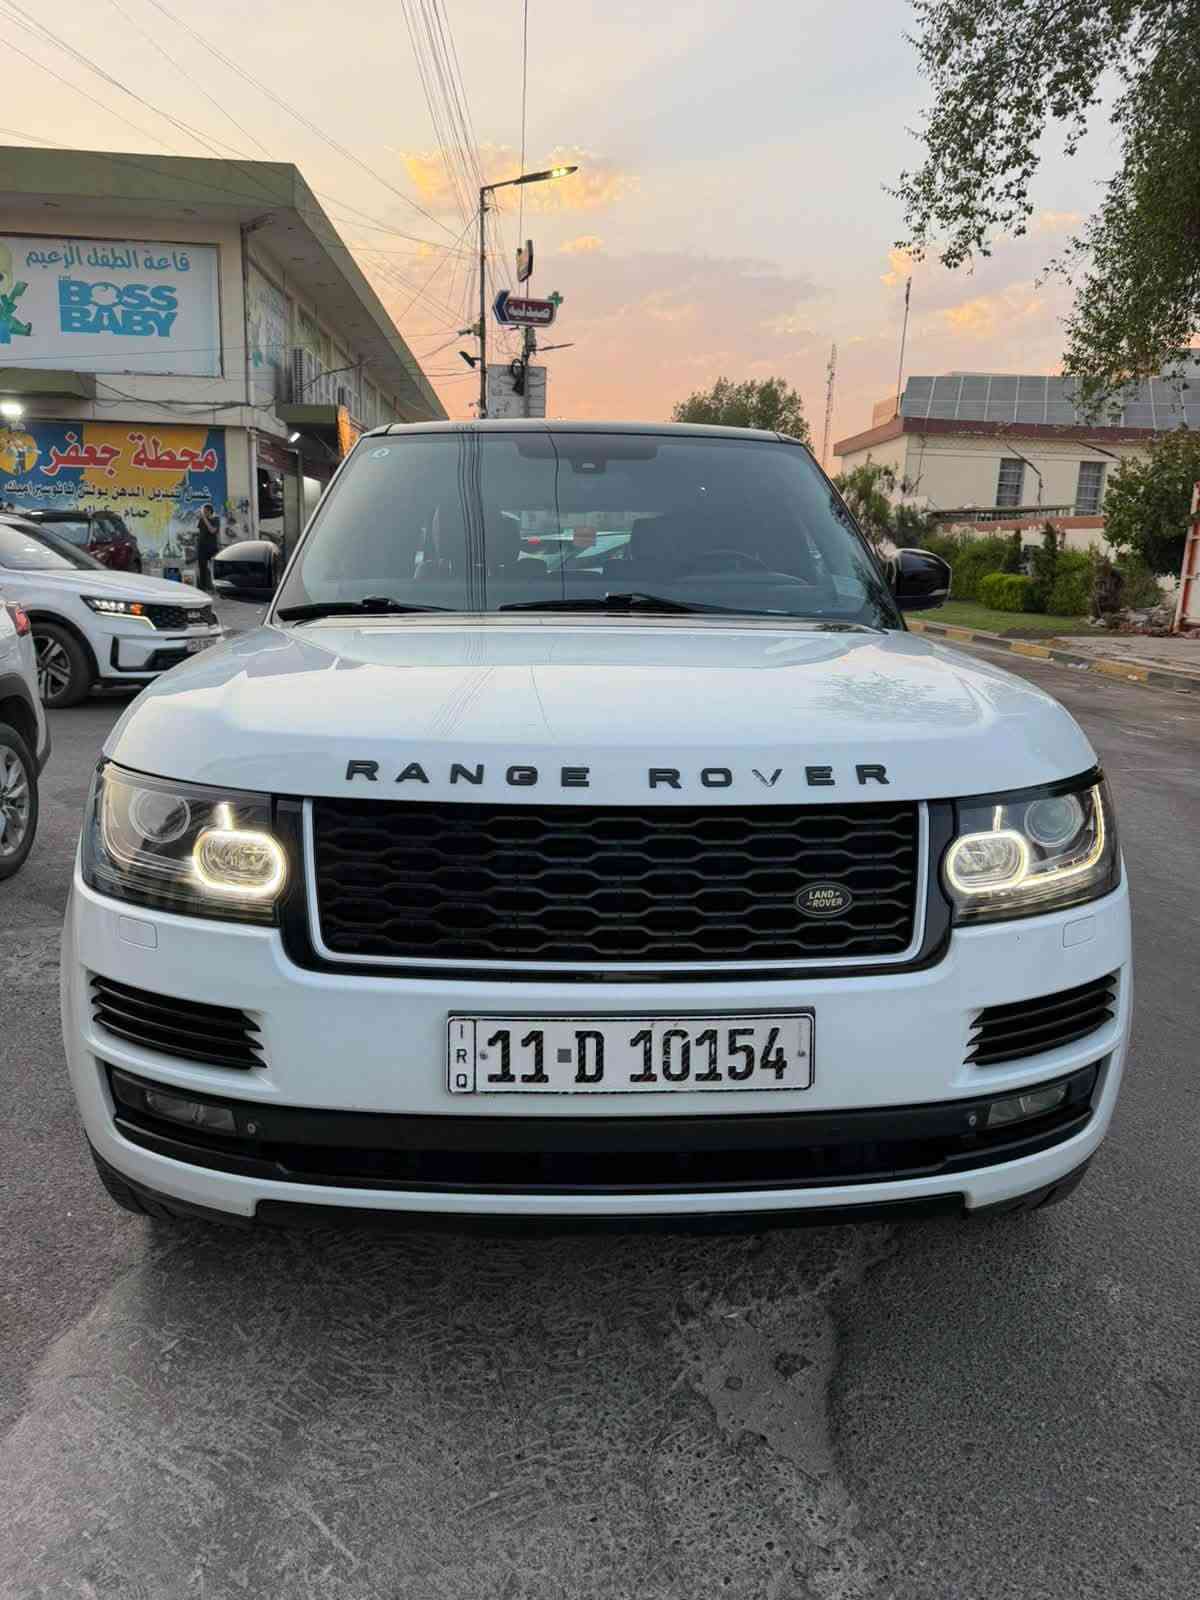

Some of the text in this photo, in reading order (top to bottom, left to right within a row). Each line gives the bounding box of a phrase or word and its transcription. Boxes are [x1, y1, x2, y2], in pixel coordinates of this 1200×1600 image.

[87, 247, 140, 270] الطفل
[143, 249, 191, 271] قاعة
[58, 279, 178, 311] BOSS
[59, 305, 178, 337] BABY
[40, 431, 218, 478] محطة جعفر
[345, 759, 890, 790] RANGE ROVER
[808, 889, 834, 900] LAND
[812, 897, 843, 908] ROVER
[487, 1027, 788, 1083] 11 D 10154
